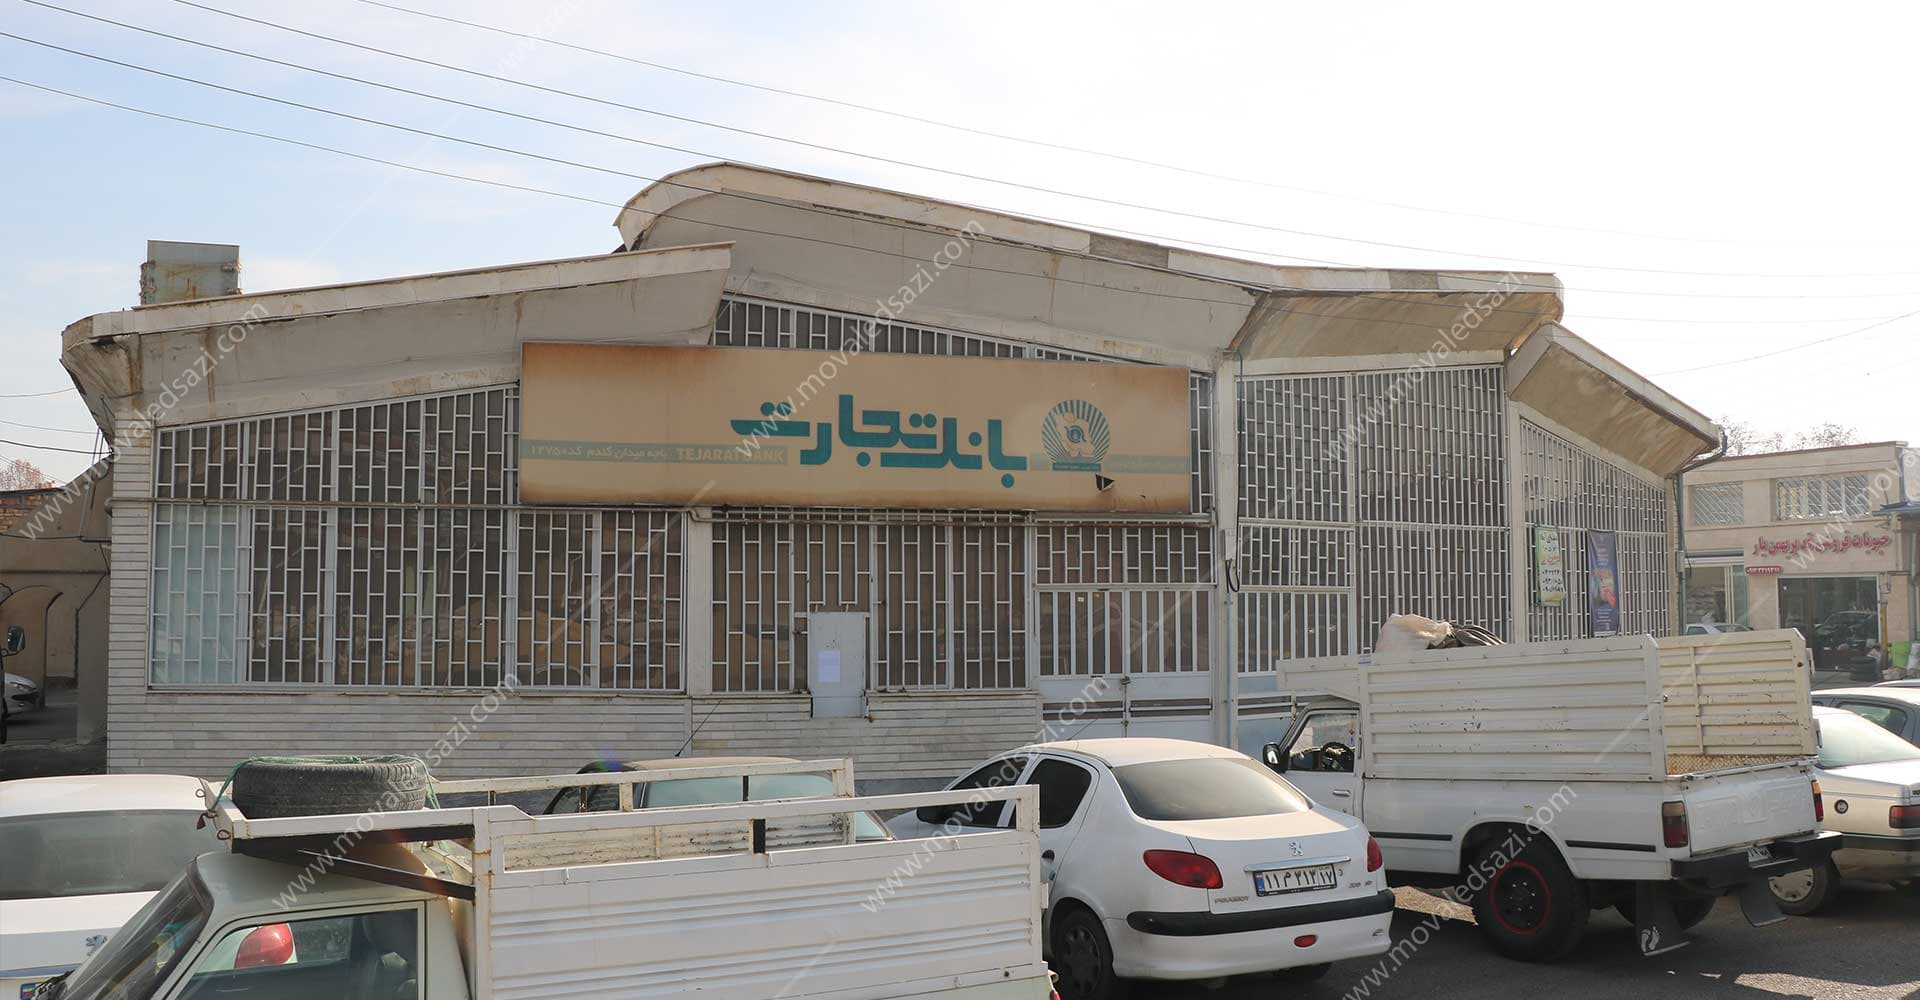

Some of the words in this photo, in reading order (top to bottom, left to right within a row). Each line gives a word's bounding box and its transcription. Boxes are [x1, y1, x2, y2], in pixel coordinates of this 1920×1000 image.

[677, 447, 741, 462] TEJARAT
[730, 394, 937, 467] تجارت
[880, 417, 1027, 488] بانک
